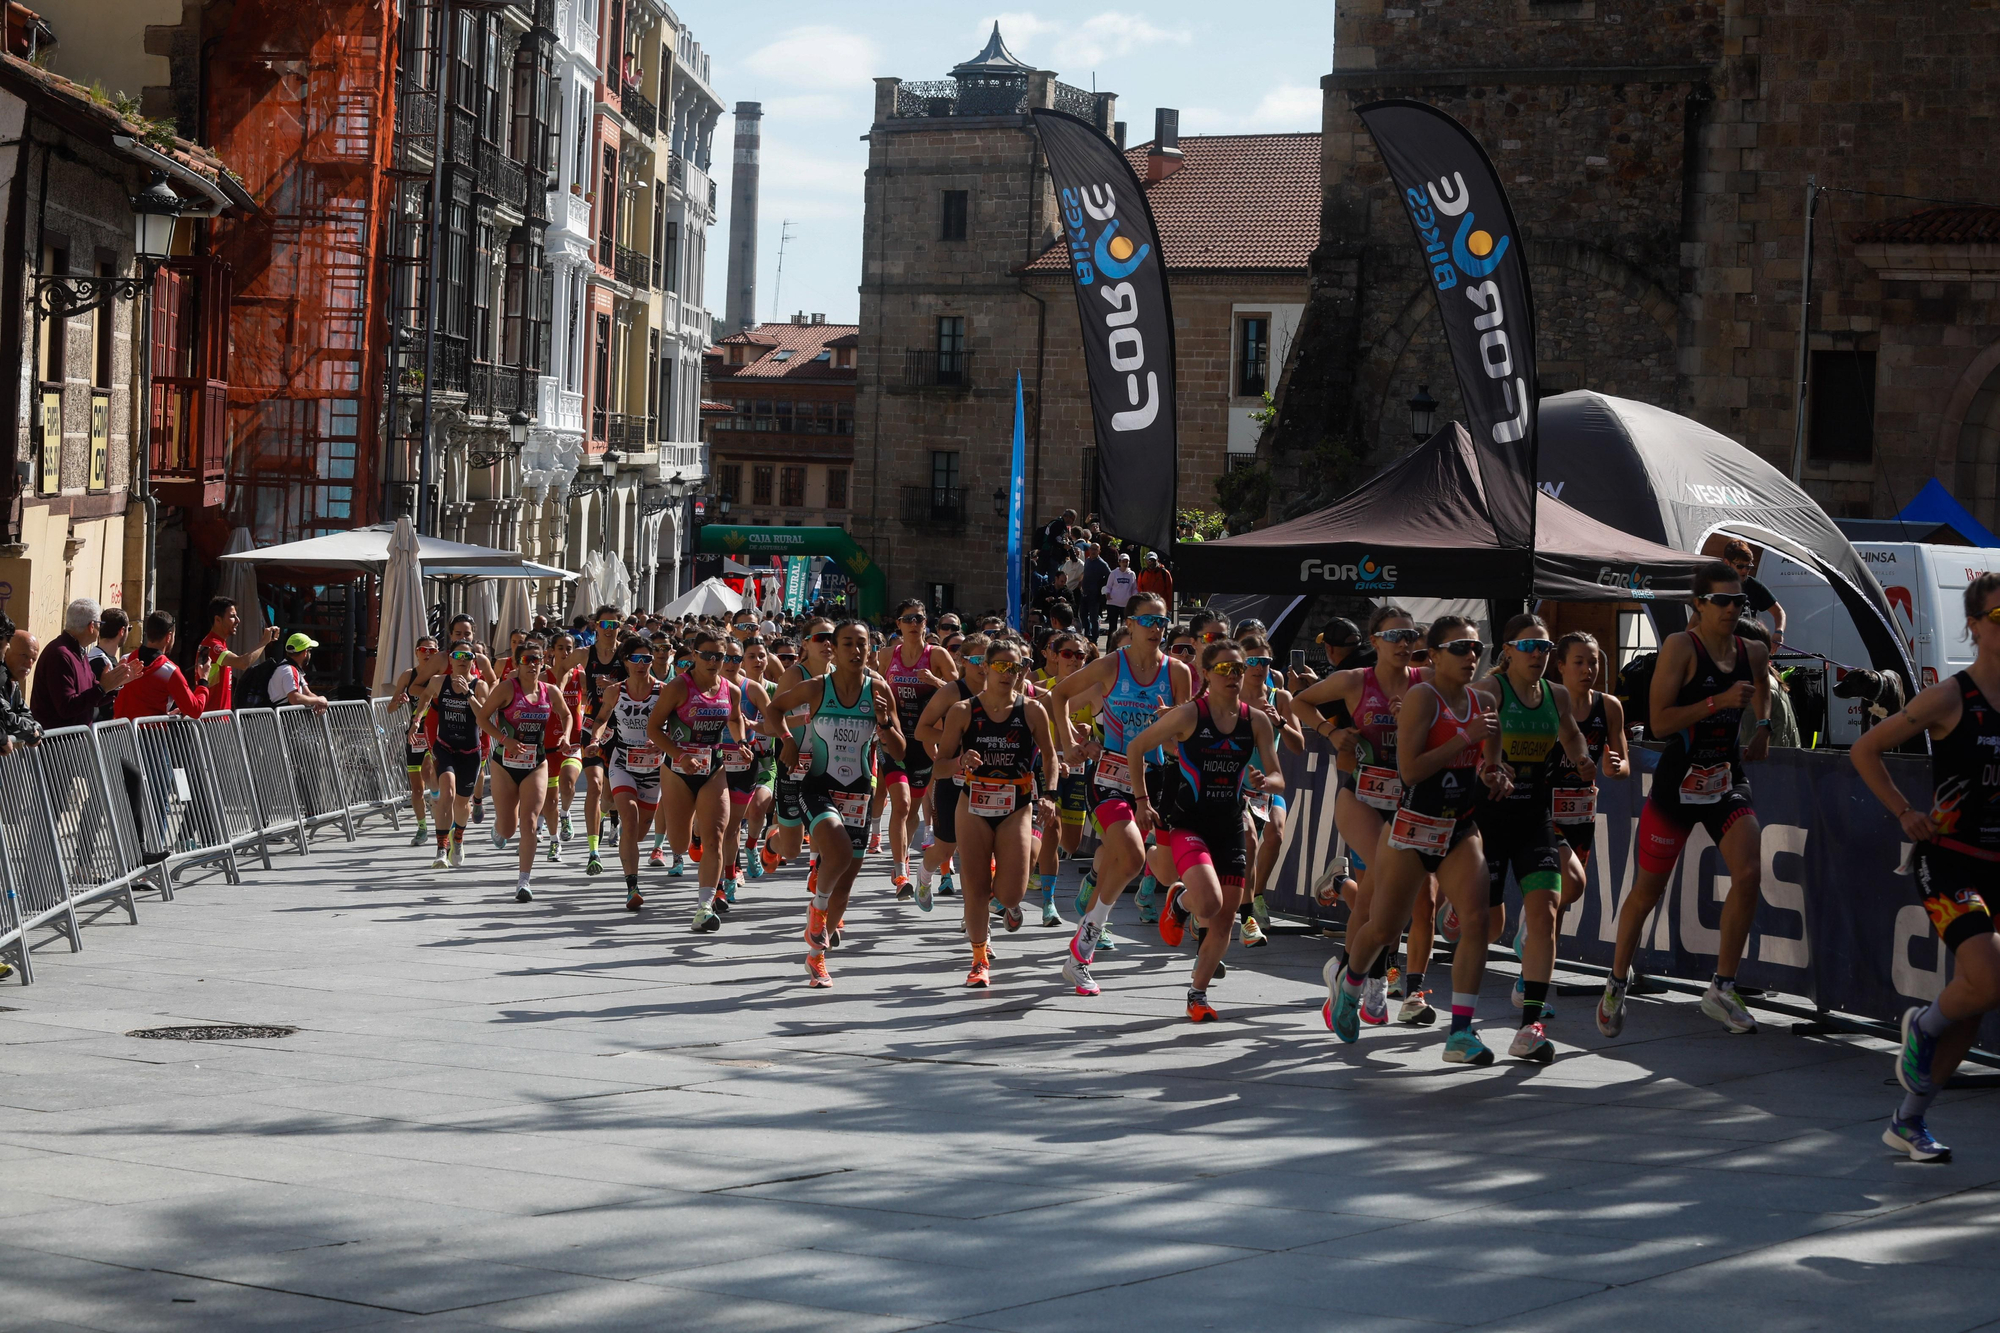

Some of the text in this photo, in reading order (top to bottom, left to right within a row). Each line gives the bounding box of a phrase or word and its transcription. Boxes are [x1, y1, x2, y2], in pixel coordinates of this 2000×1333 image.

[748, 534, 805, 544] CAJA RURAL
[789, 562, 801, 596] RURAL
[1355, 581, 1396, 590] BIKES
[897, 686, 918, 700] PIERA
[833, 728, 860, 743] ASSOU
[1509, 740, 1549, 757] BURGAYA
[632, 756, 645, 765] 27
[983, 750, 1016, 766] ÁLVAREZ
[1105, 764, 1120, 777] 77
[1203, 760, 1240, 773] HIDALGO
[1367, 779, 1385, 793] 14
[1694, 779, 1704, 791] 5
[977, 795, 990, 805] 67
[1560, 801, 1576, 812] 33
[1406, 827, 1416, 839] 4
